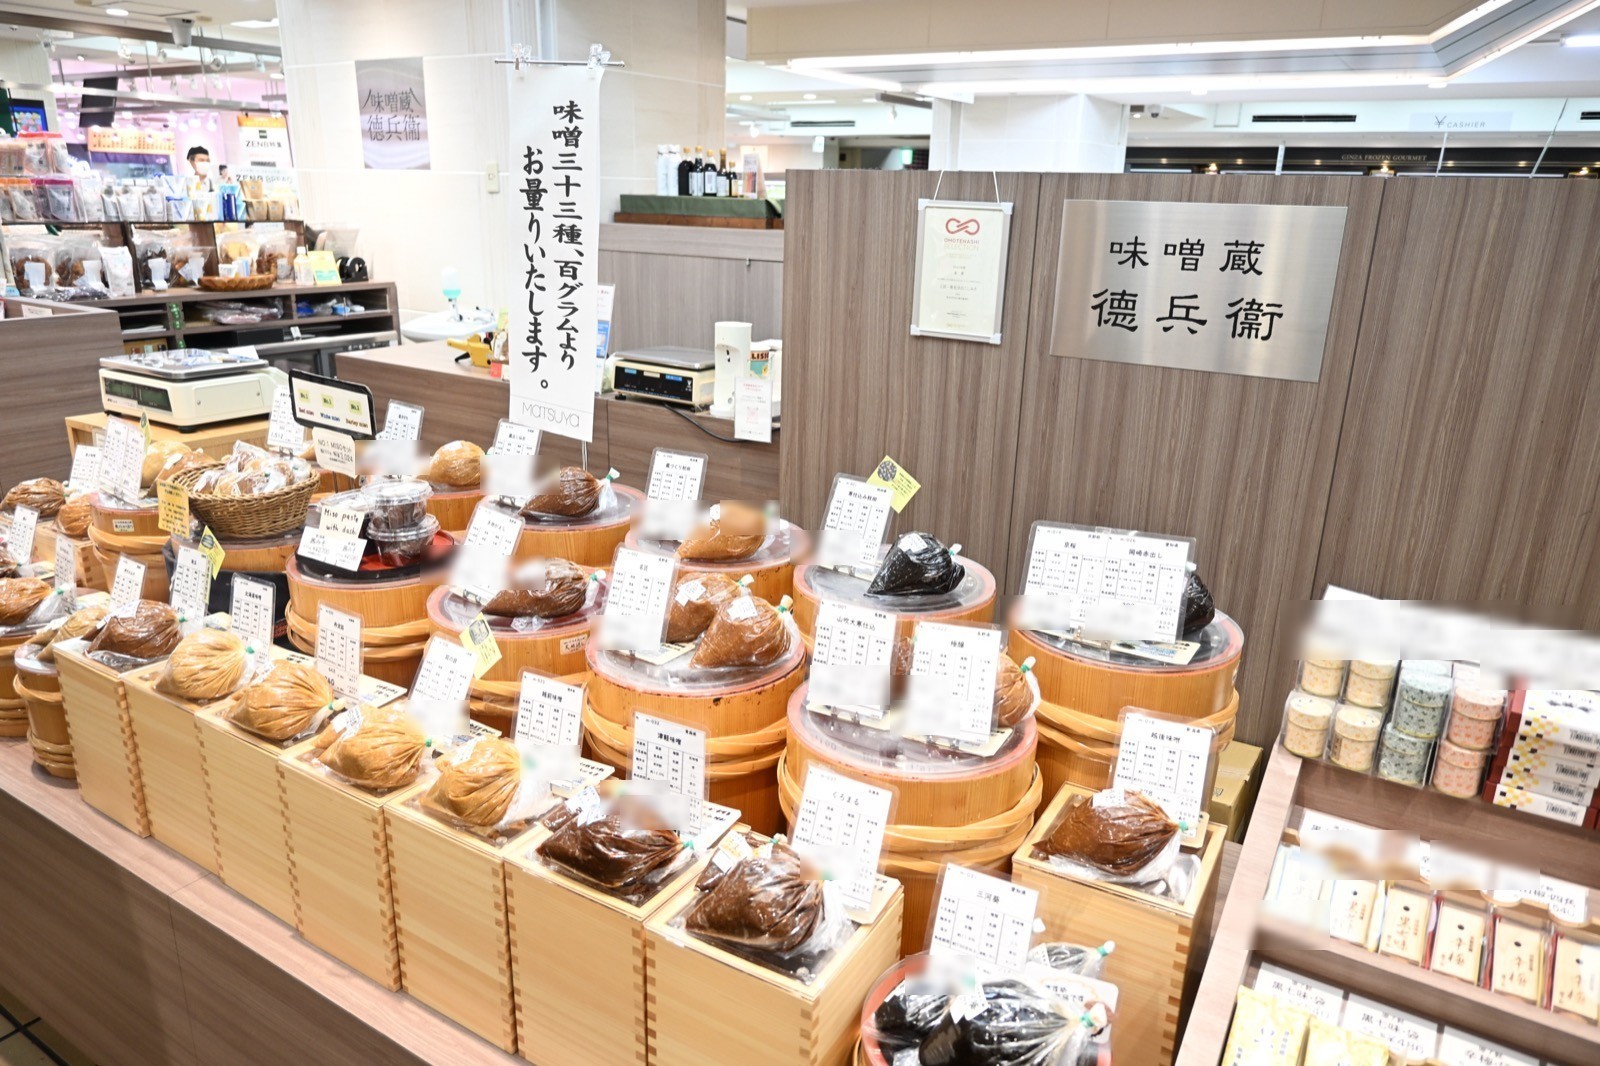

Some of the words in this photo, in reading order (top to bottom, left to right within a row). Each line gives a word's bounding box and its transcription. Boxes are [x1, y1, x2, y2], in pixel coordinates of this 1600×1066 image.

[1341, 154, 1363, 162] GINZA
[1364, 154, 1391, 162] FROZEN
[1392, 154, 1428, 162] GOURMET
[551, 99, 585, 371] 味噌三十三種、百グラムより
[519, 145, 549, 390] お量りいたします。
[1109, 235, 1265, 276] 味噌蔵
[324, 508, 339, 518] Miso
[341, 512, 360, 523] paste
[326, 524, 339, 532] with
